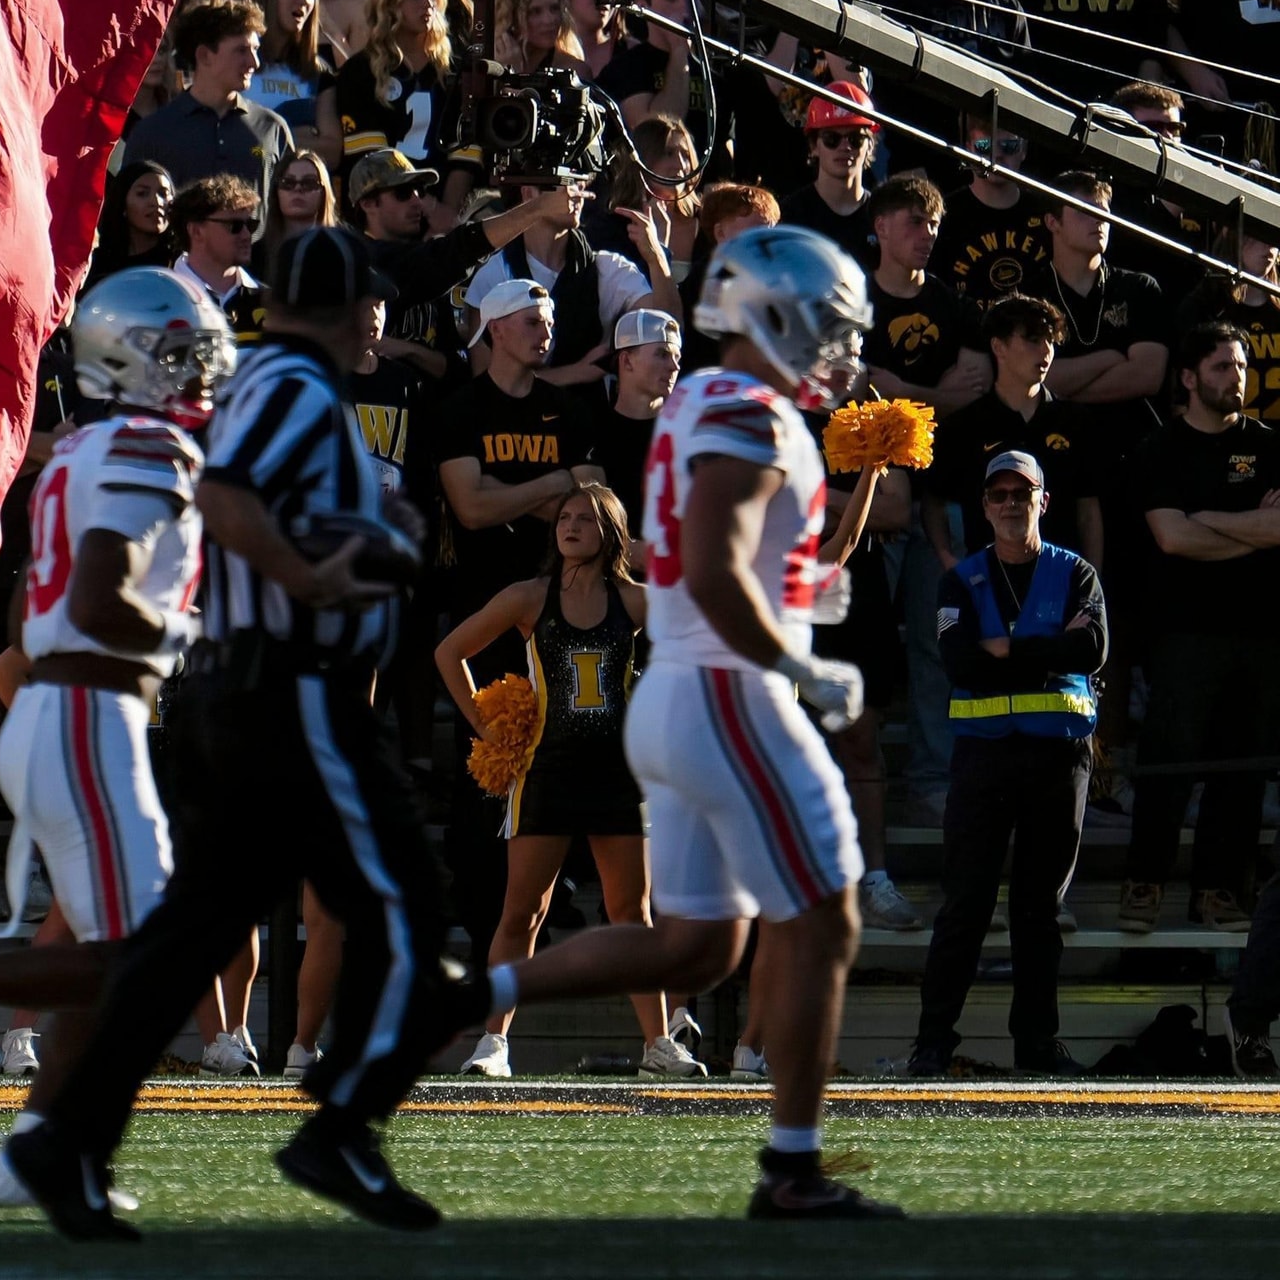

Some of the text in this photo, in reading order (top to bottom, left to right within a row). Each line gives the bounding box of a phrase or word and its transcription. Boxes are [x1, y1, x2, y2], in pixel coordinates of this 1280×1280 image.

[395, 91, 433, 161] 1
[482, 433, 560, 465] IOWA
[570, 650, 606, 711] I
